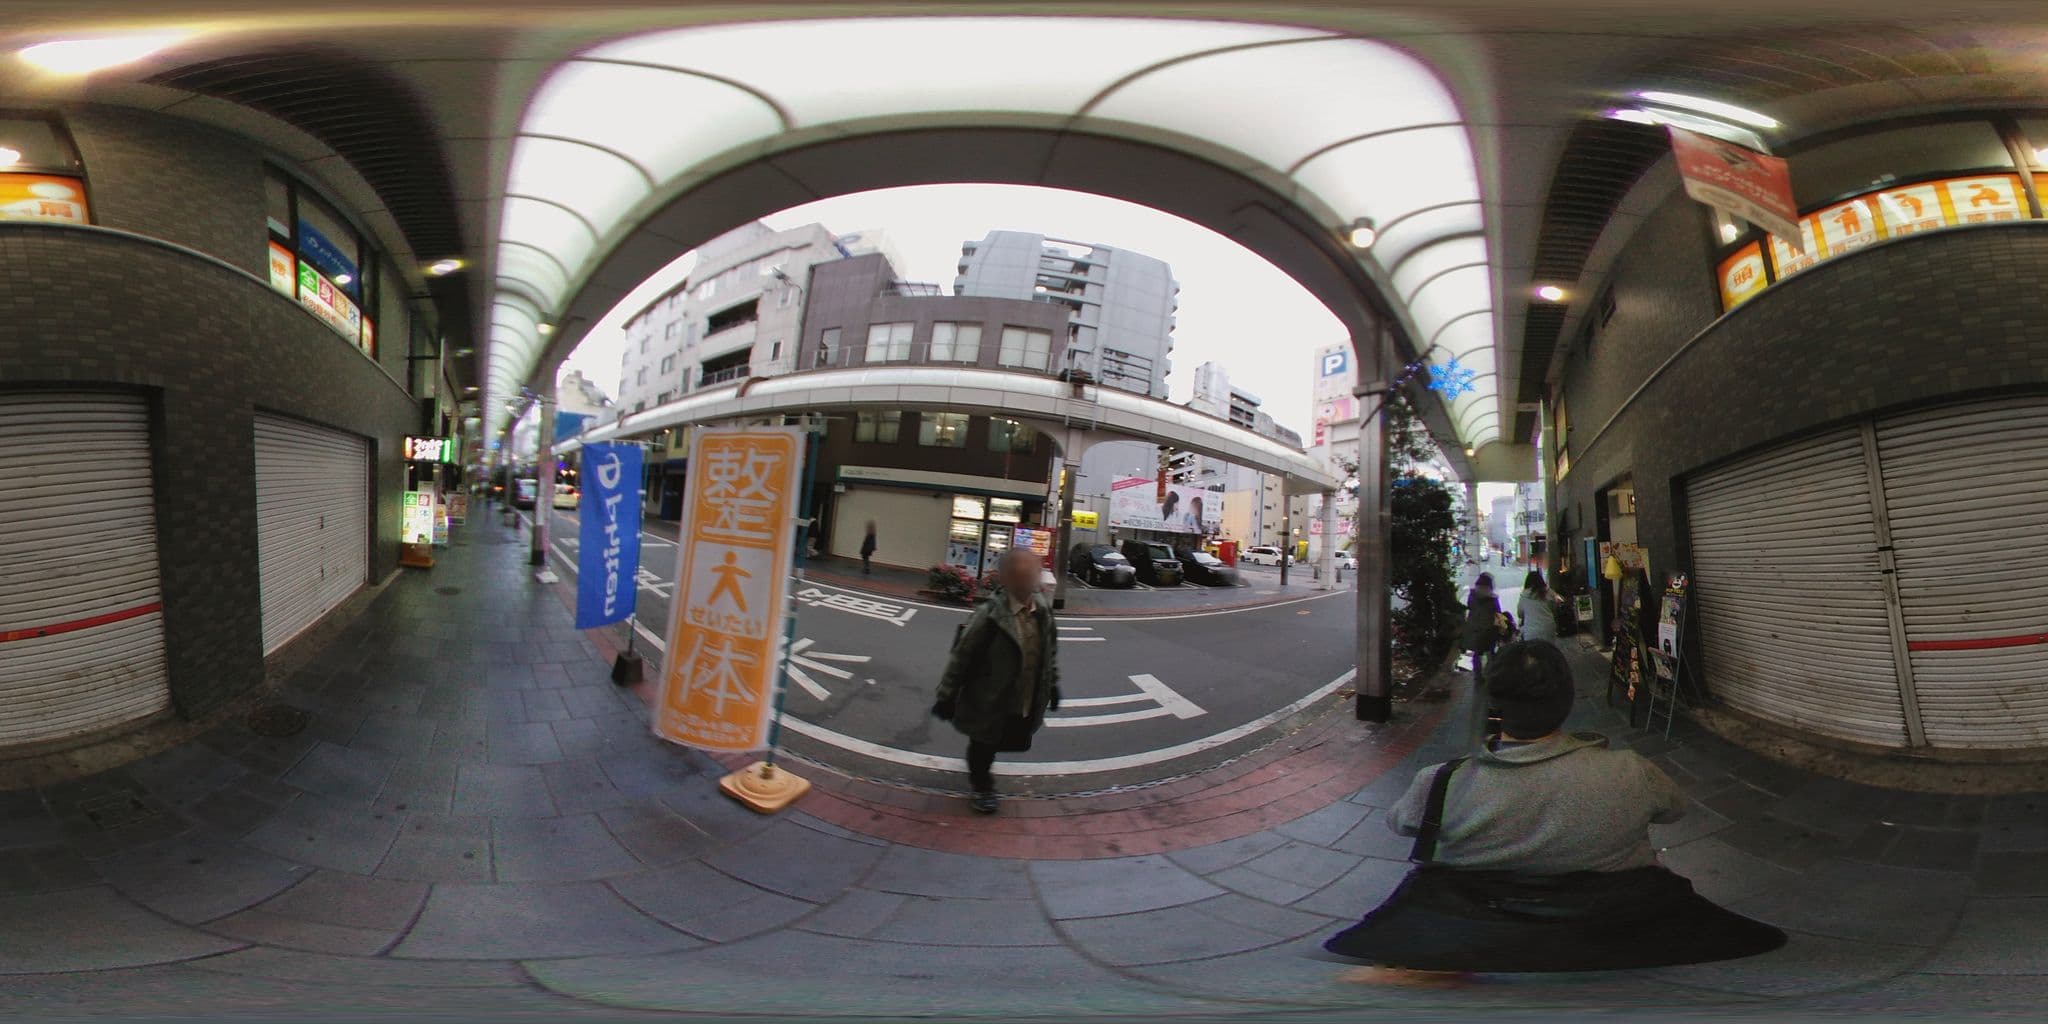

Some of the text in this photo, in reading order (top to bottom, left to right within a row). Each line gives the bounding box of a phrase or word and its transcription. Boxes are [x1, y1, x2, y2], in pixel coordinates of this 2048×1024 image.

[1325, 354, 1344, 376] P
[689, 606, 764, 637] せいたい
